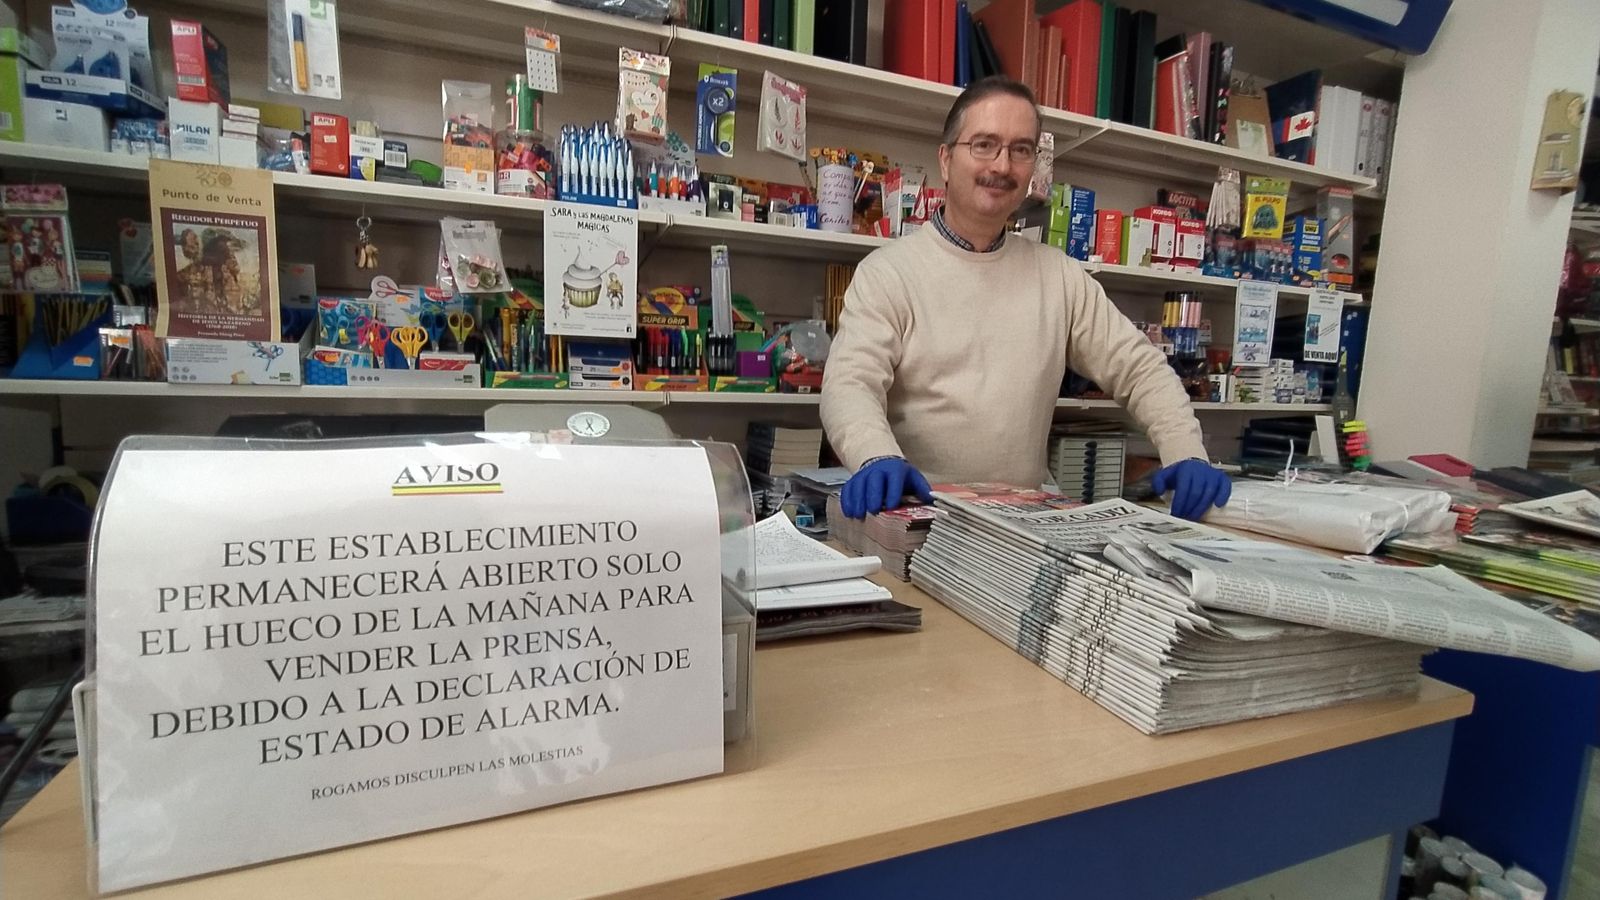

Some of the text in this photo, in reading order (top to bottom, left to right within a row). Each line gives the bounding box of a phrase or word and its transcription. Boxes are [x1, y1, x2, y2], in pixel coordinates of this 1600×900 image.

[176, 124, 210, 135] MILAN
[162, 189, 262, 206] Punto de Venta
[1168, 192, 1197, 207] LOCTITE
[171, 213, 259, 227] REGIDOR PERPETUO
[550, 207, 572, 217] SARA
[642, 315, 666, 324] SUPER
[667, 316, 686, 325] GRIP
[1304, 350, 1311, 359] DE
[1311, 351, 1324, 360] VENTA
[394, 462, 500, 484] AVISO
[222, 520, 637, 567] ESTE ESTABLECIMIENTO
[158, 551, 682, 613] PERMANECERÁ ABIERTO SOLO
[139, 583, 694, 657] EL HUECO DE LA MAÑANA PARA
[264, 625, 613, 683] VENDER LA PRENSA,
[150, 648, 691, 740] DEBIDO A LA DECLARACIÓN DE
[259, 692, 620, 765] ESTADO DE ALARMA.
[311, 746, 584, 800] ROGAMOS DISCULPEN LAS MOLESTIAS
